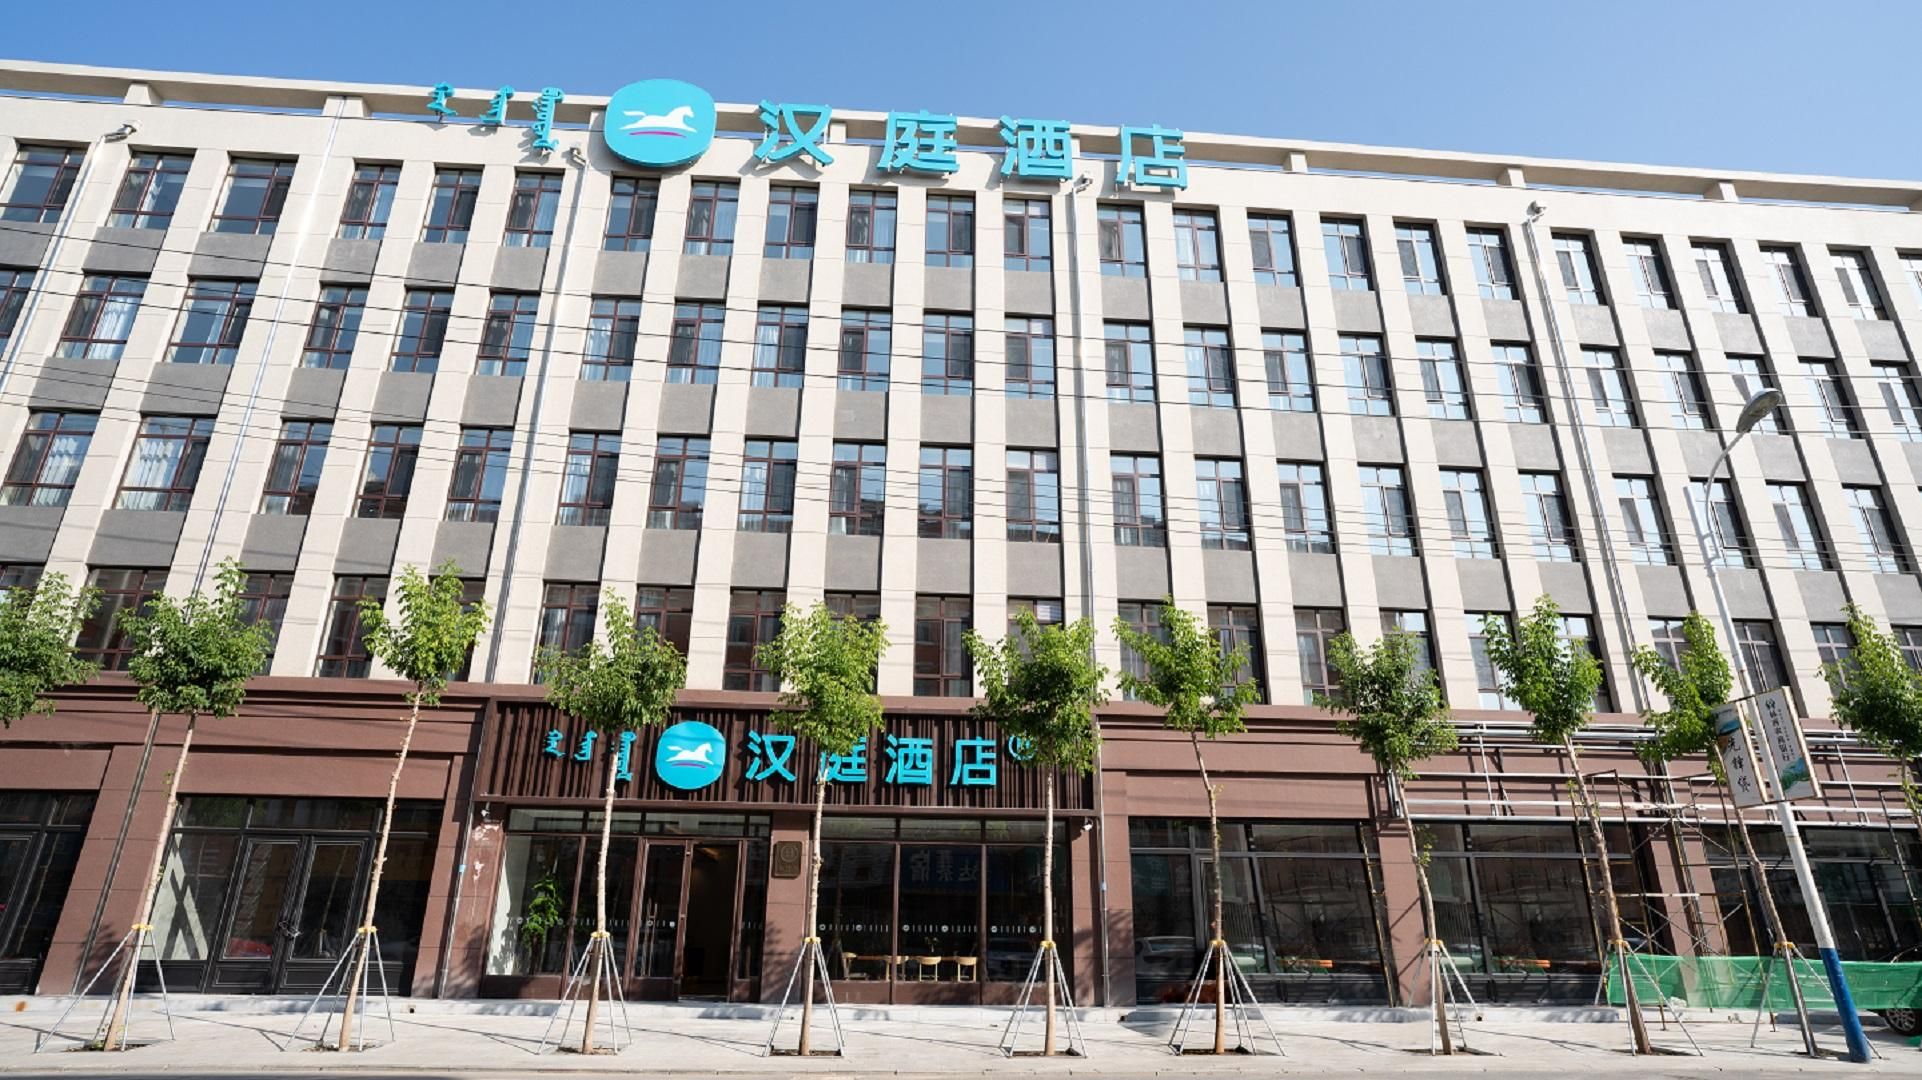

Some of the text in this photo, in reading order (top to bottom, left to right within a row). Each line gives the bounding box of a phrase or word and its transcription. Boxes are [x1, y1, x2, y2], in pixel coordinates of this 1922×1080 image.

[754, 99, 1187, 191] 汉庭酒店
[745, 730, 997, 786] 汉庭酒店
